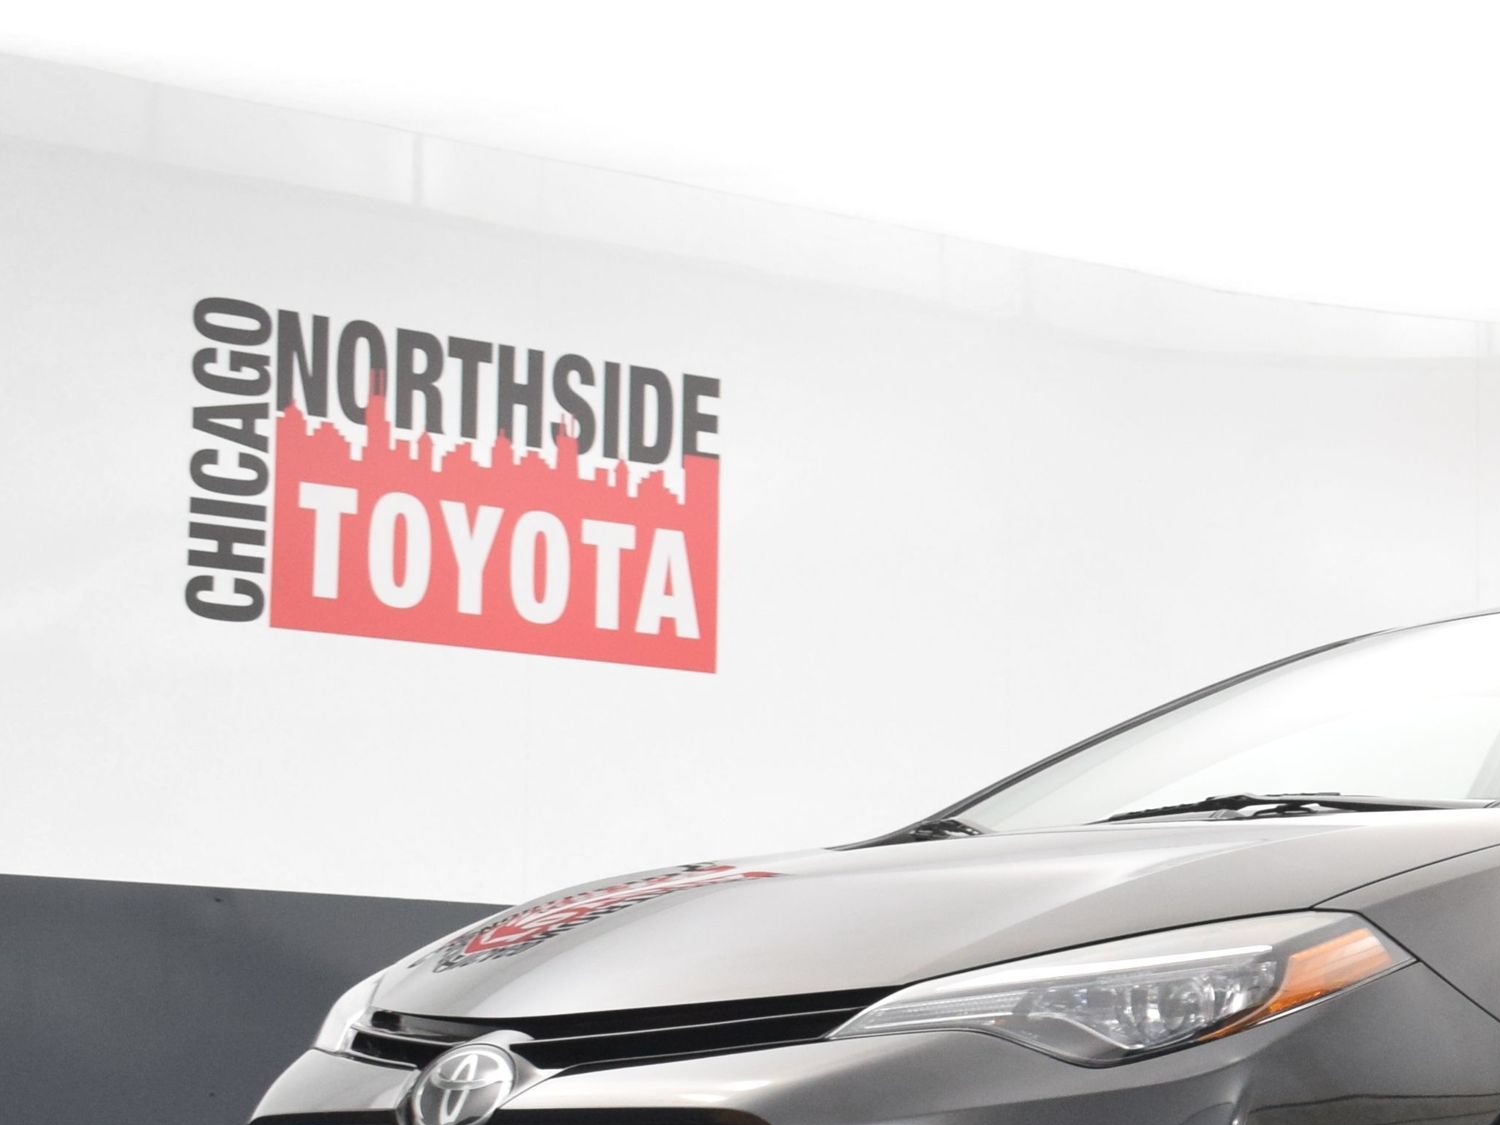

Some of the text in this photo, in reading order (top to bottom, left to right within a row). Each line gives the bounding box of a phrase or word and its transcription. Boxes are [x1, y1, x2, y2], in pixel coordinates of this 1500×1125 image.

[184, 296, 273, 623] CHICAGO
[277, 309, 720, 469] NORTHSIDE
[299, 481, 701, 640] TOYOTA
